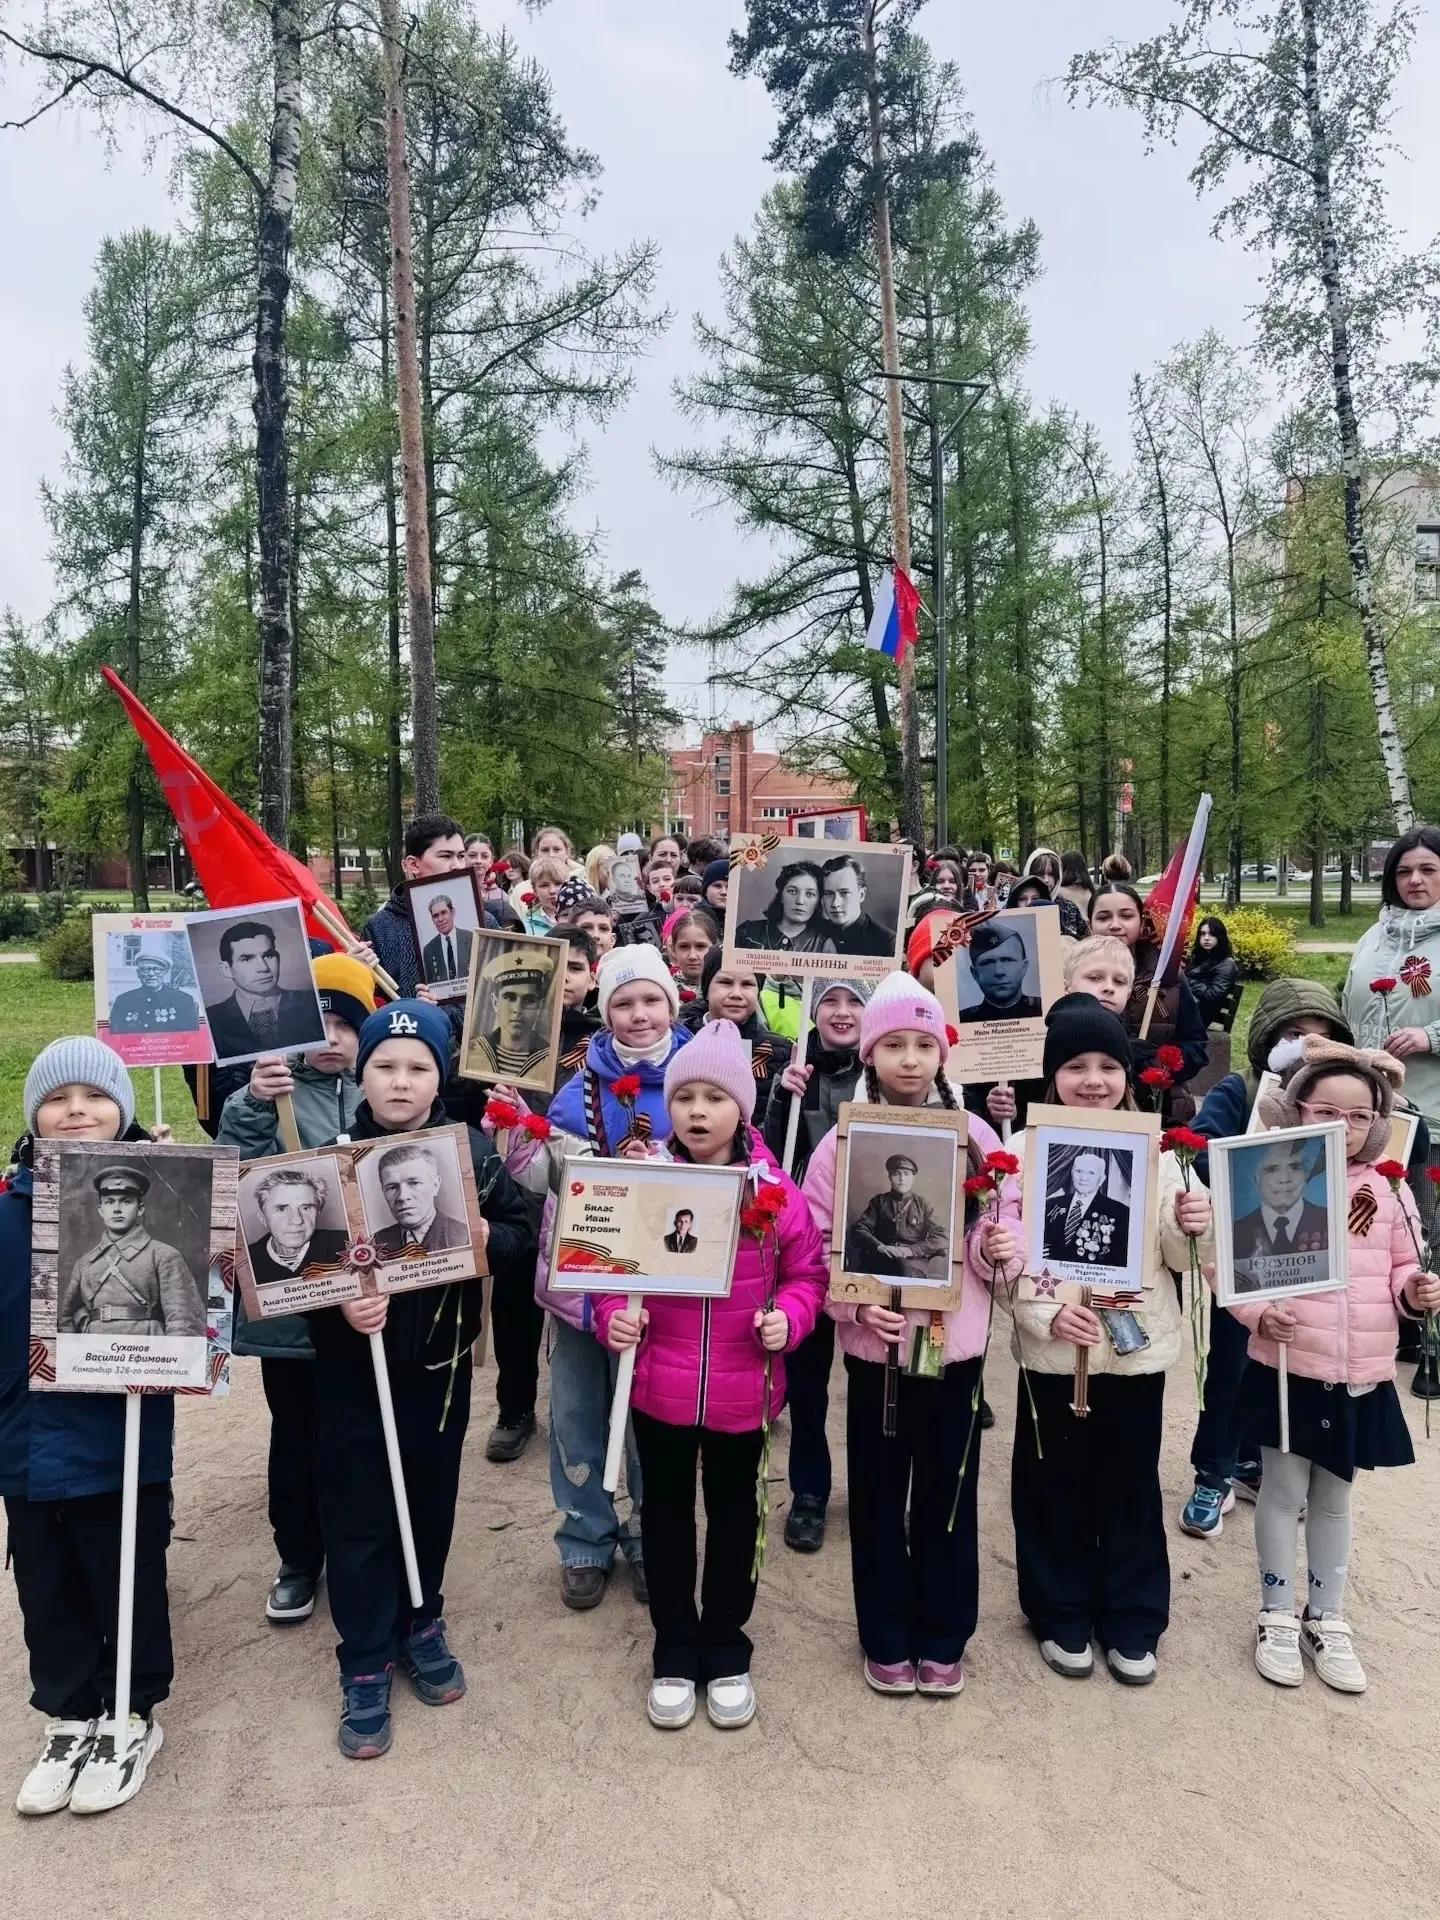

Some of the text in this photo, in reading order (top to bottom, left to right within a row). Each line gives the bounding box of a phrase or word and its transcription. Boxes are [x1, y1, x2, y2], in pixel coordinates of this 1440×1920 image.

[791, 957, 848, 970] ШАНИНЫ
[388, 1010, 418, 1035] LA
[991, 1026, 1031, 1036] Михайлович
[584, 1204, 614, 1213] Билас
[585, 1214, 610, 1223] Иван
[572, 1224, 621, 1233] Петрович
[401, 1257, 448, 1272] Васильев
[1248, 1255, 1316, 1271] ЮСУПОВ
[388, 1264, 464, 1282] Сергей Егорович
[283, 1280, 333, 1294] Васильев
[262, 1285, 358, 1307] Анатолий Сергеевич
[110, 1342, 150, 1353] Суханов
[85, 1352, 178, 1364] Василий Ефимович
[115, 1366, 142, 1375] 328-го
